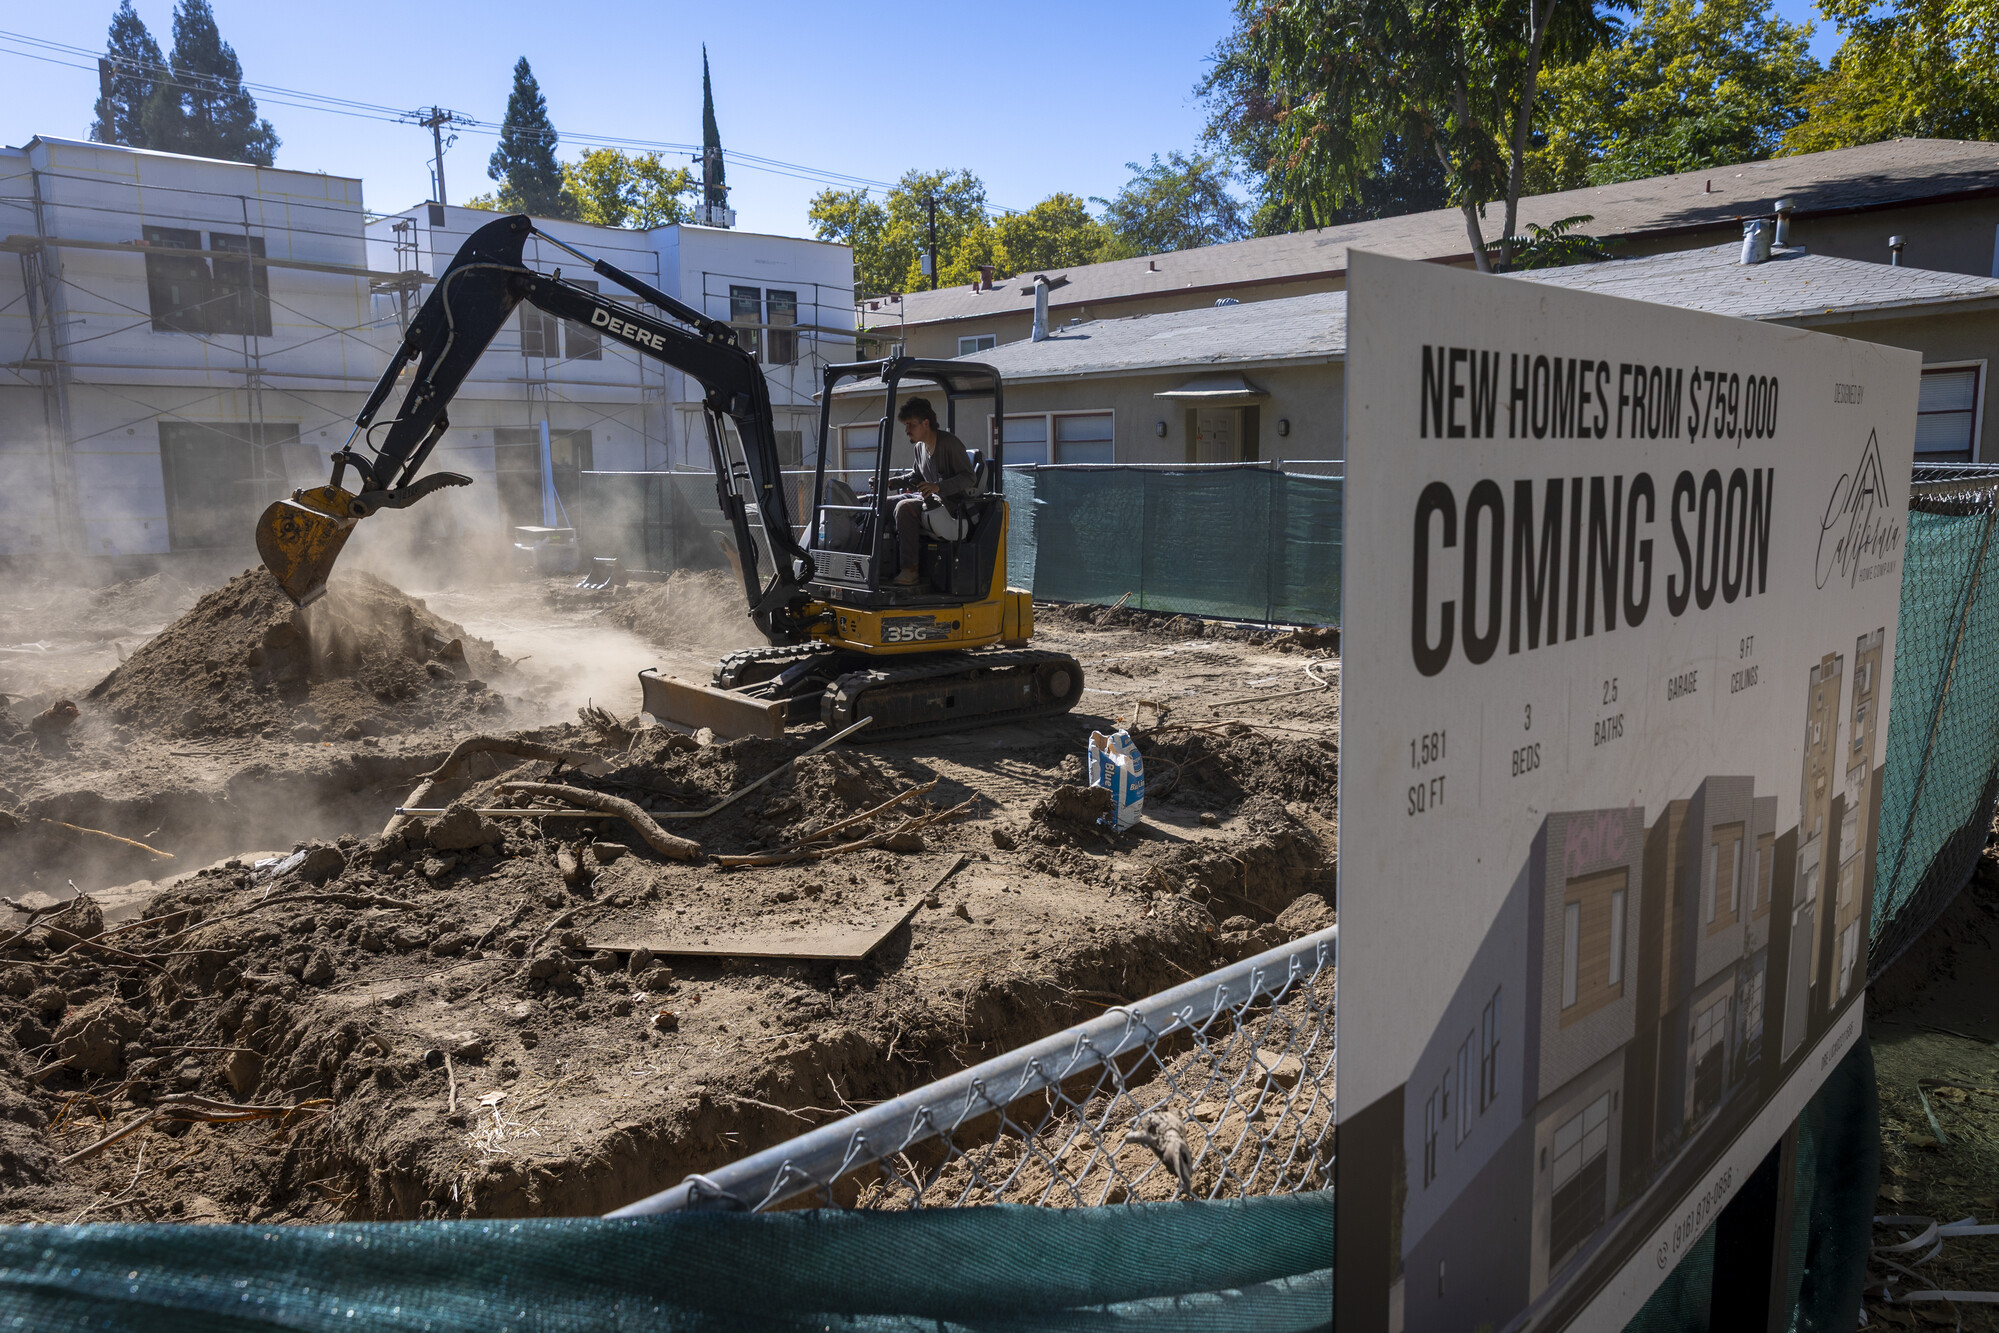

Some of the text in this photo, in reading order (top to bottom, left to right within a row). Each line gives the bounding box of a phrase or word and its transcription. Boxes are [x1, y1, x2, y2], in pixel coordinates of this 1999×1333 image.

[591, 307, 667, 351] DEERE
[1420, 345, 1779, 449] NEW HOMES FROM $759,000
[1815, 473, 1900, 590] California
[1411, 467, 1775, 677] COMING SOON
[888, 627, 927, 642] 35G
[1739, 635, 1755, 660] 9 FT
[1602, 677, 1618, 706] 2.5
[1667, 670, 1698, 702] GARAGE
[1730, 664, 1759, 695] CEILINGS
[1524, 703, 1532, 731] 3
[1594, 713, 1624, 747] BATHS
[1410, 730, 1447, 770] 1,581
[1512, 742, 1541, 778] BEDS
[1104, 762, 1115, 787] Blue
[1408, 775, 1446, 817] SQ FT
